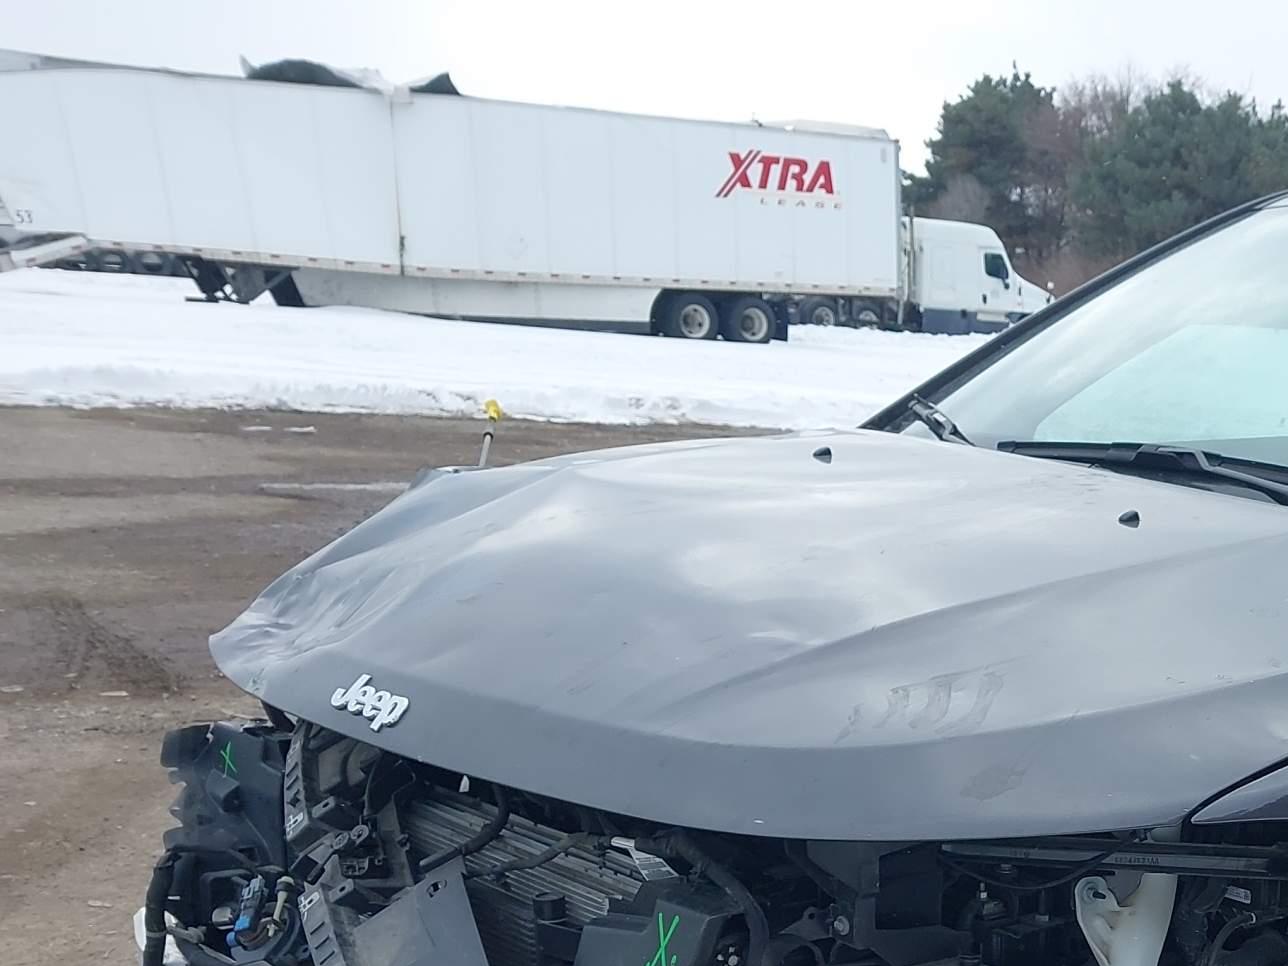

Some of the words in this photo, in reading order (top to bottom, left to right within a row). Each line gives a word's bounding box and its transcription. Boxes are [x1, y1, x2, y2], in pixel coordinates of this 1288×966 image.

[716, 150, 834, 196] XTRA
[16, 208, 33, 225] 53
[330, 673, 410, 733] Jeep
